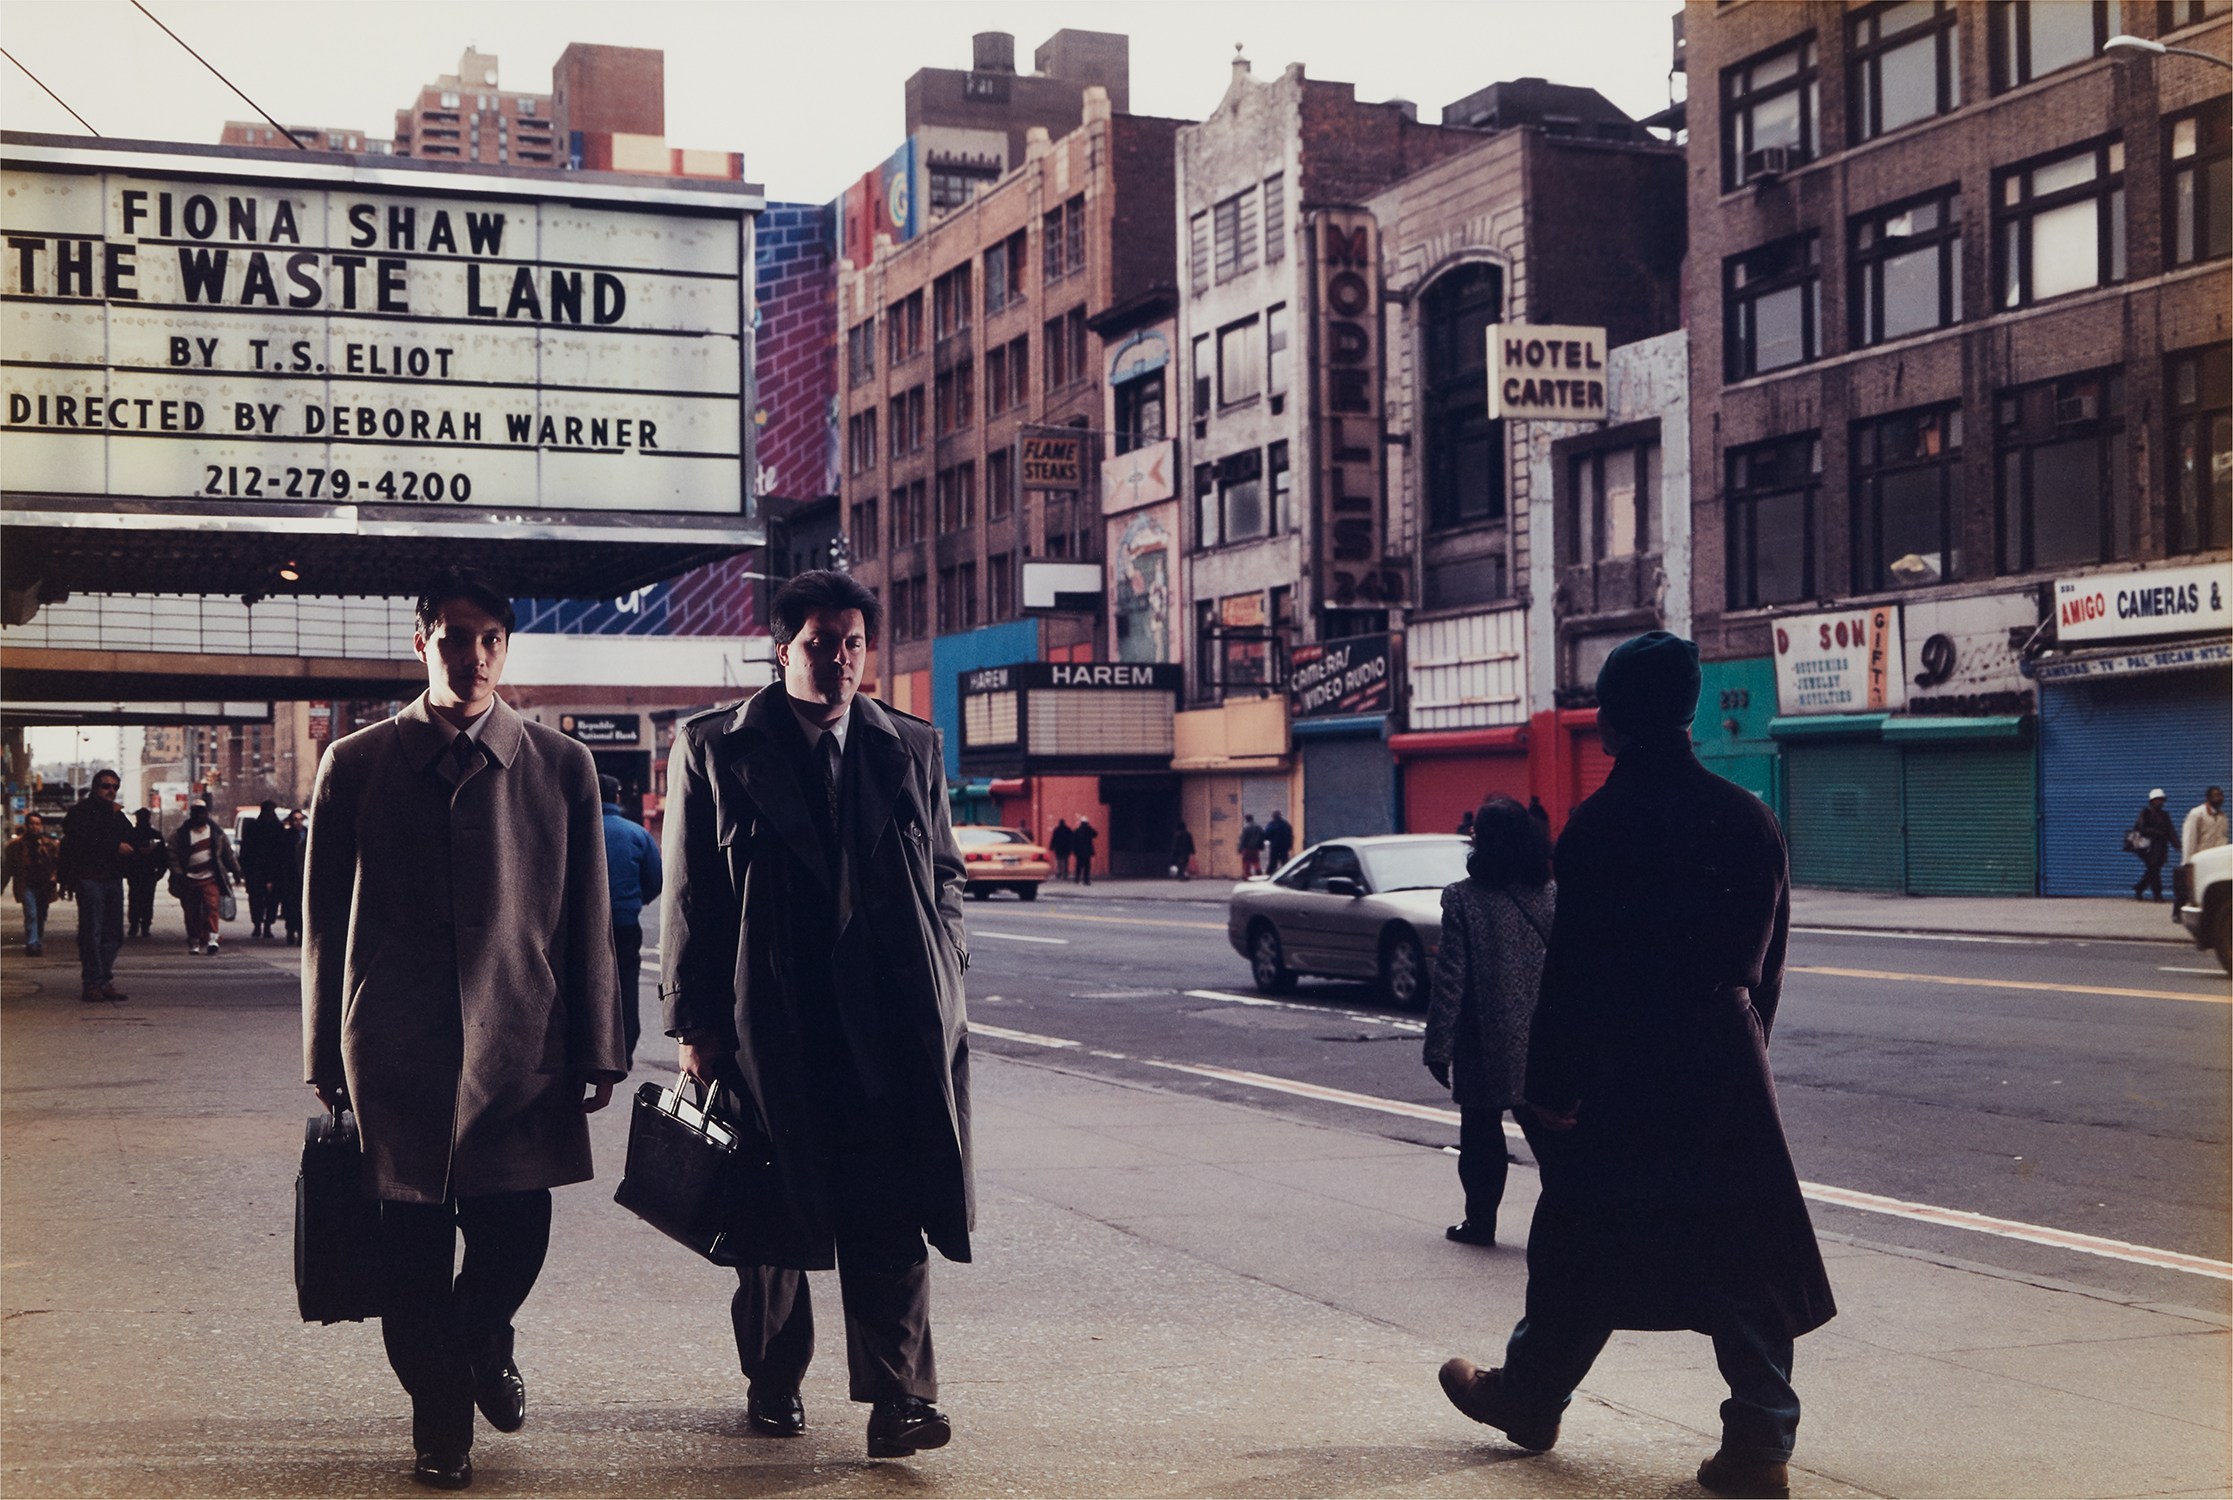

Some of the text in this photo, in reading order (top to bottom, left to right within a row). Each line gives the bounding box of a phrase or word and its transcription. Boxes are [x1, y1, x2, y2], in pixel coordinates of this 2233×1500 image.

[122, 188, 506, 256] FIONA SHAW
[6, 236, 627, 325] THE WASTE LAND
[170, 336, 455, 378] BY T.S. ELIOT
[1505, 339, 1602, 369] HOTEL
[1503, 377, 1604, 408] CARTER
[10, 393, 659, 449] DIRECTED BY DEBORAH WARNER
[1024, 441, 1076, 460] FLAME
[205, 464, 472, 504] 212-279-4200
[1024, 463, 1077, 480] STEAKS
[2062, 581, 2223, 627] AMIGO CAMERAS &
[1819, 618, 1867, 651] SON
[969, 668, 1009, 690] HAREM
[1052, 665, 1153, 686] HAREM
[2099, 659, 2115, 672] TV
[1305, 678, 1343, 709] VIDEO
[1345, 656, 1386, 692] AUDIO
